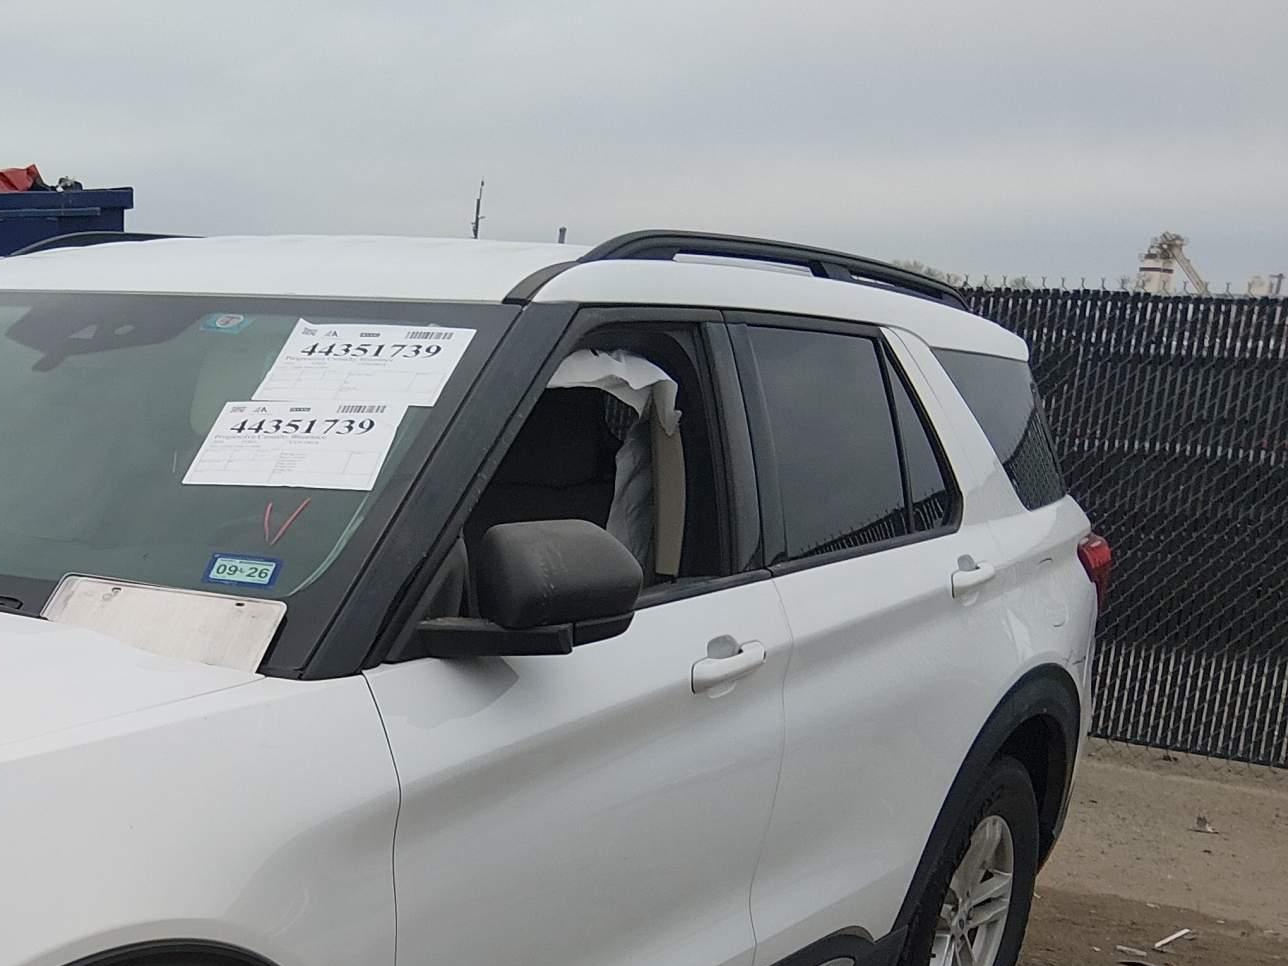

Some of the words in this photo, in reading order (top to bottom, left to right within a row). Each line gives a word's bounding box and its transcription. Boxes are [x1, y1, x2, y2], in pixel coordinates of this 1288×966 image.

[300, 342, 442, 359] 44351739
[230, 418, 376, 435] 44351739
[215, 563, 239, 576] 09
[245, 566, 270, 579] 26
